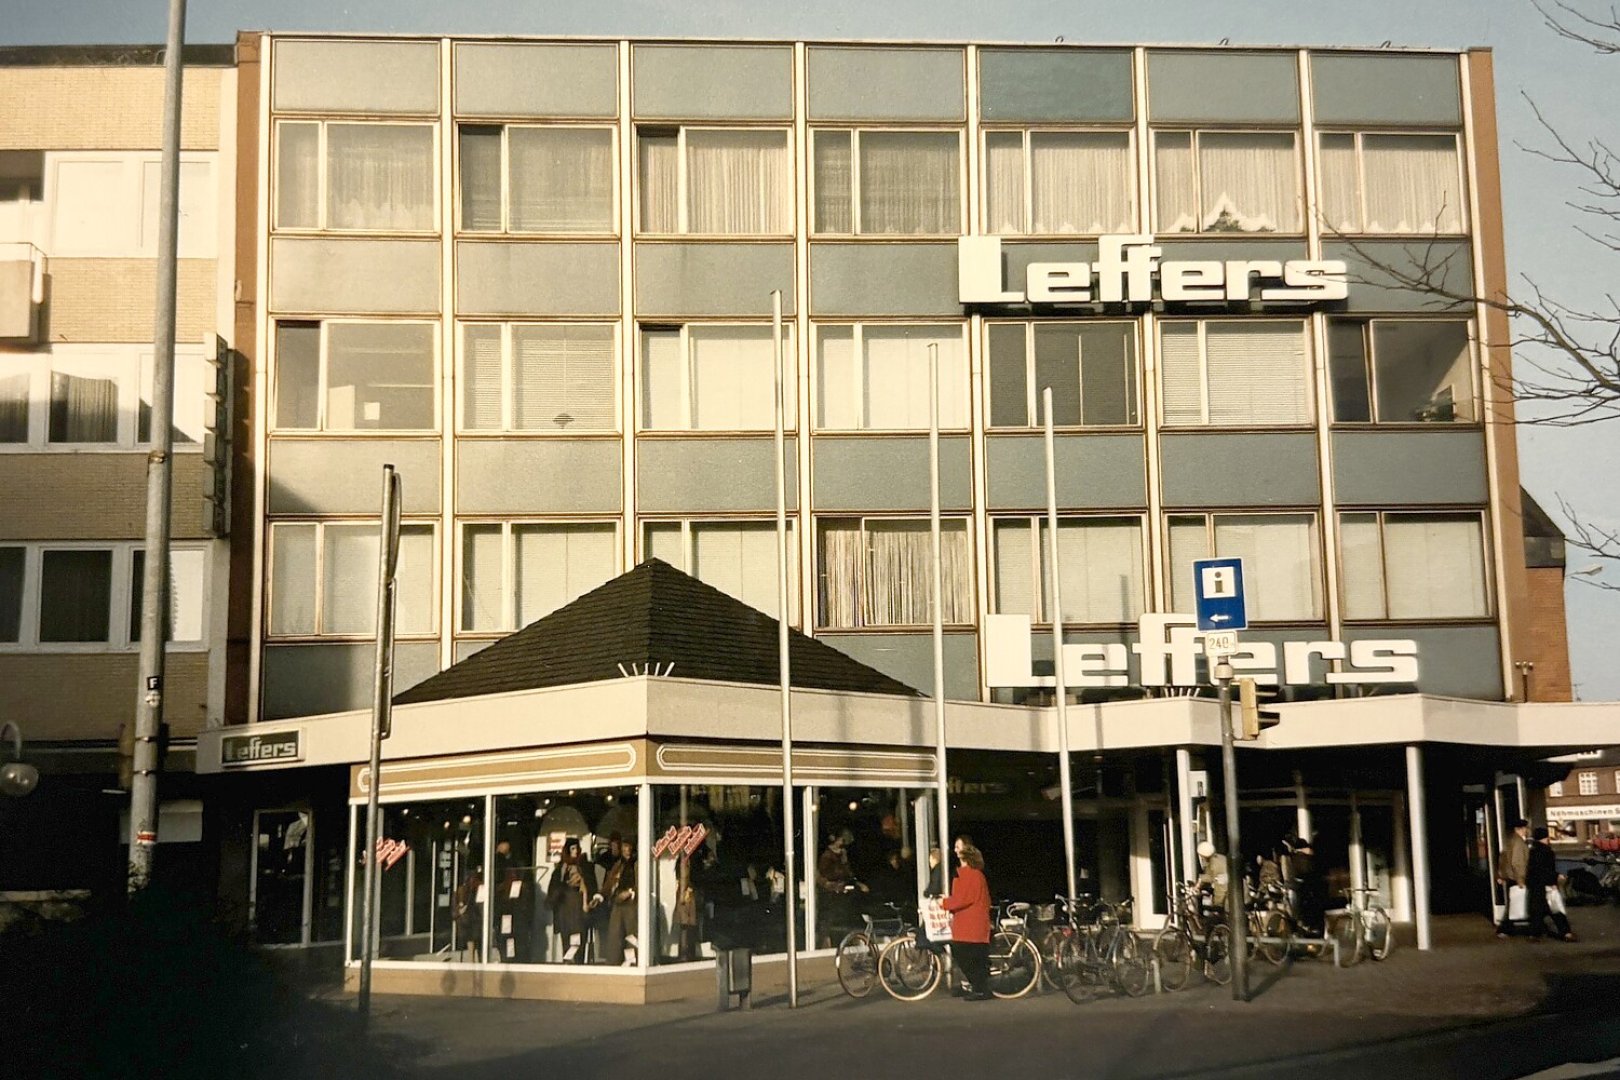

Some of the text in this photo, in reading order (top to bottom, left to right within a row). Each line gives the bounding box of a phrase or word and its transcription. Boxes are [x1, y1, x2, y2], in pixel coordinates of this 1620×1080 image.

[958, 234, 1349, 304] Leffers
[986, 613, 1419, 687] Leffers
[149, 677, 159, 689] F
[225, 736, 297, 762] Leffers
